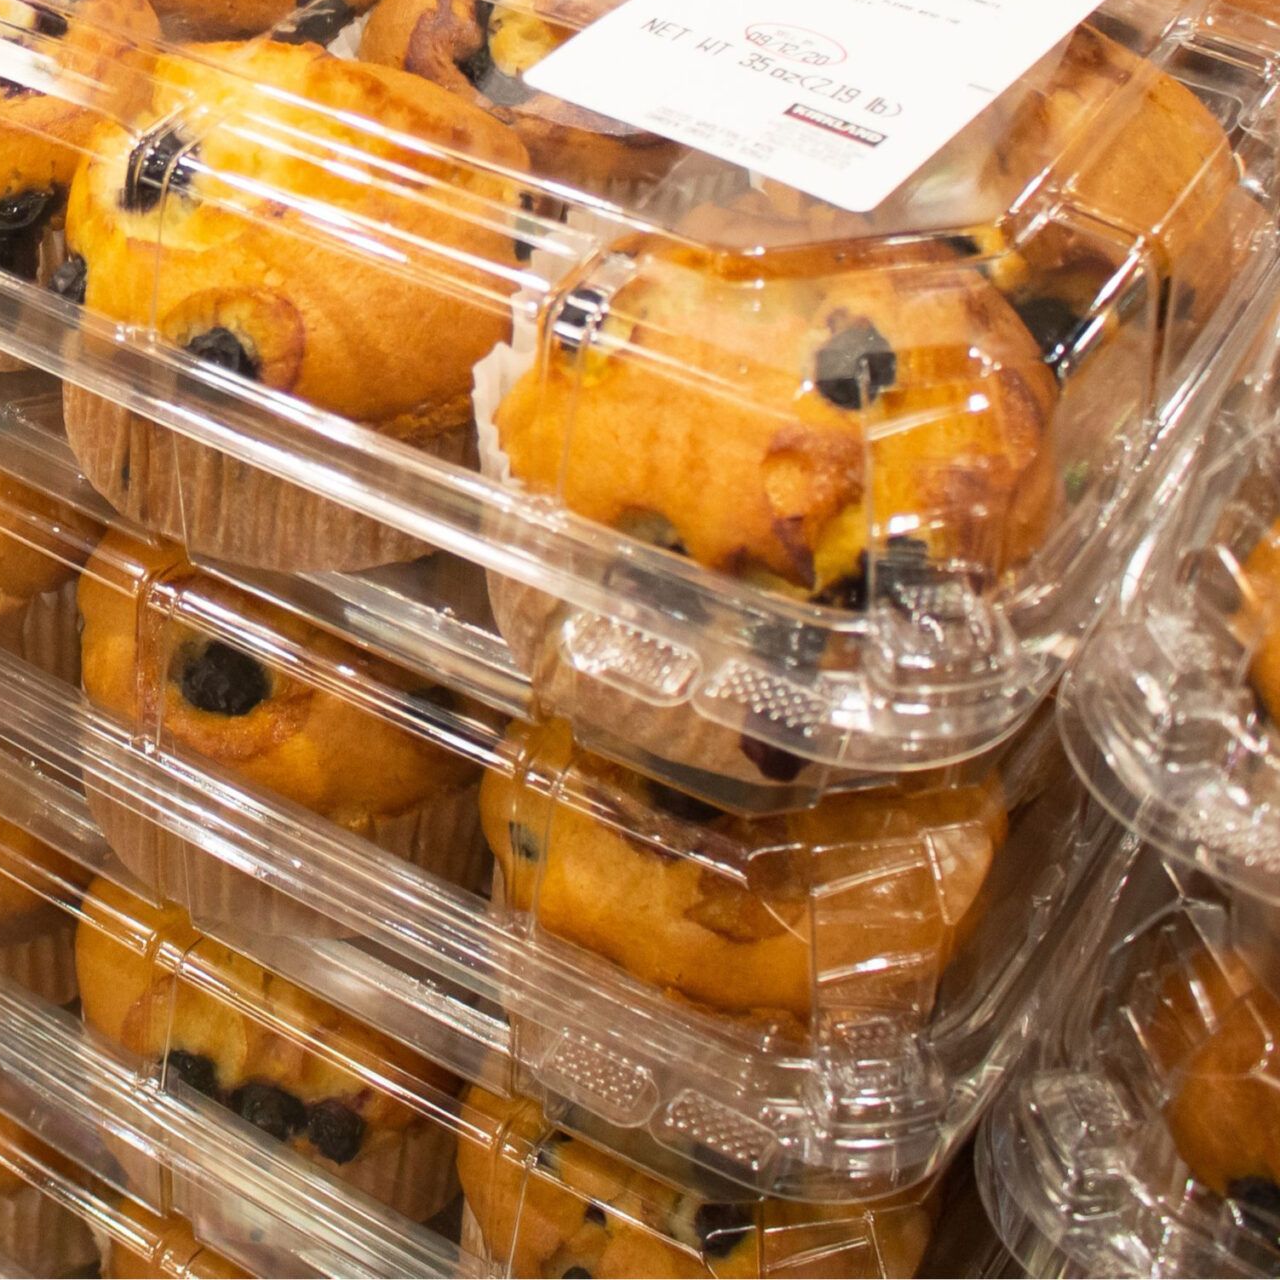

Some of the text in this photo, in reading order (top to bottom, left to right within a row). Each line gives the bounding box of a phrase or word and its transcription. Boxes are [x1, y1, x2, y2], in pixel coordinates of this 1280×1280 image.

[641, 17, 690, 42] NET
[696, 37, 734, 56] WT
[865, 96, 903, 118] lb)
[748, 30, 830, 67] 09/12/20
[790, 104, 885, 143] KIRKLAND
